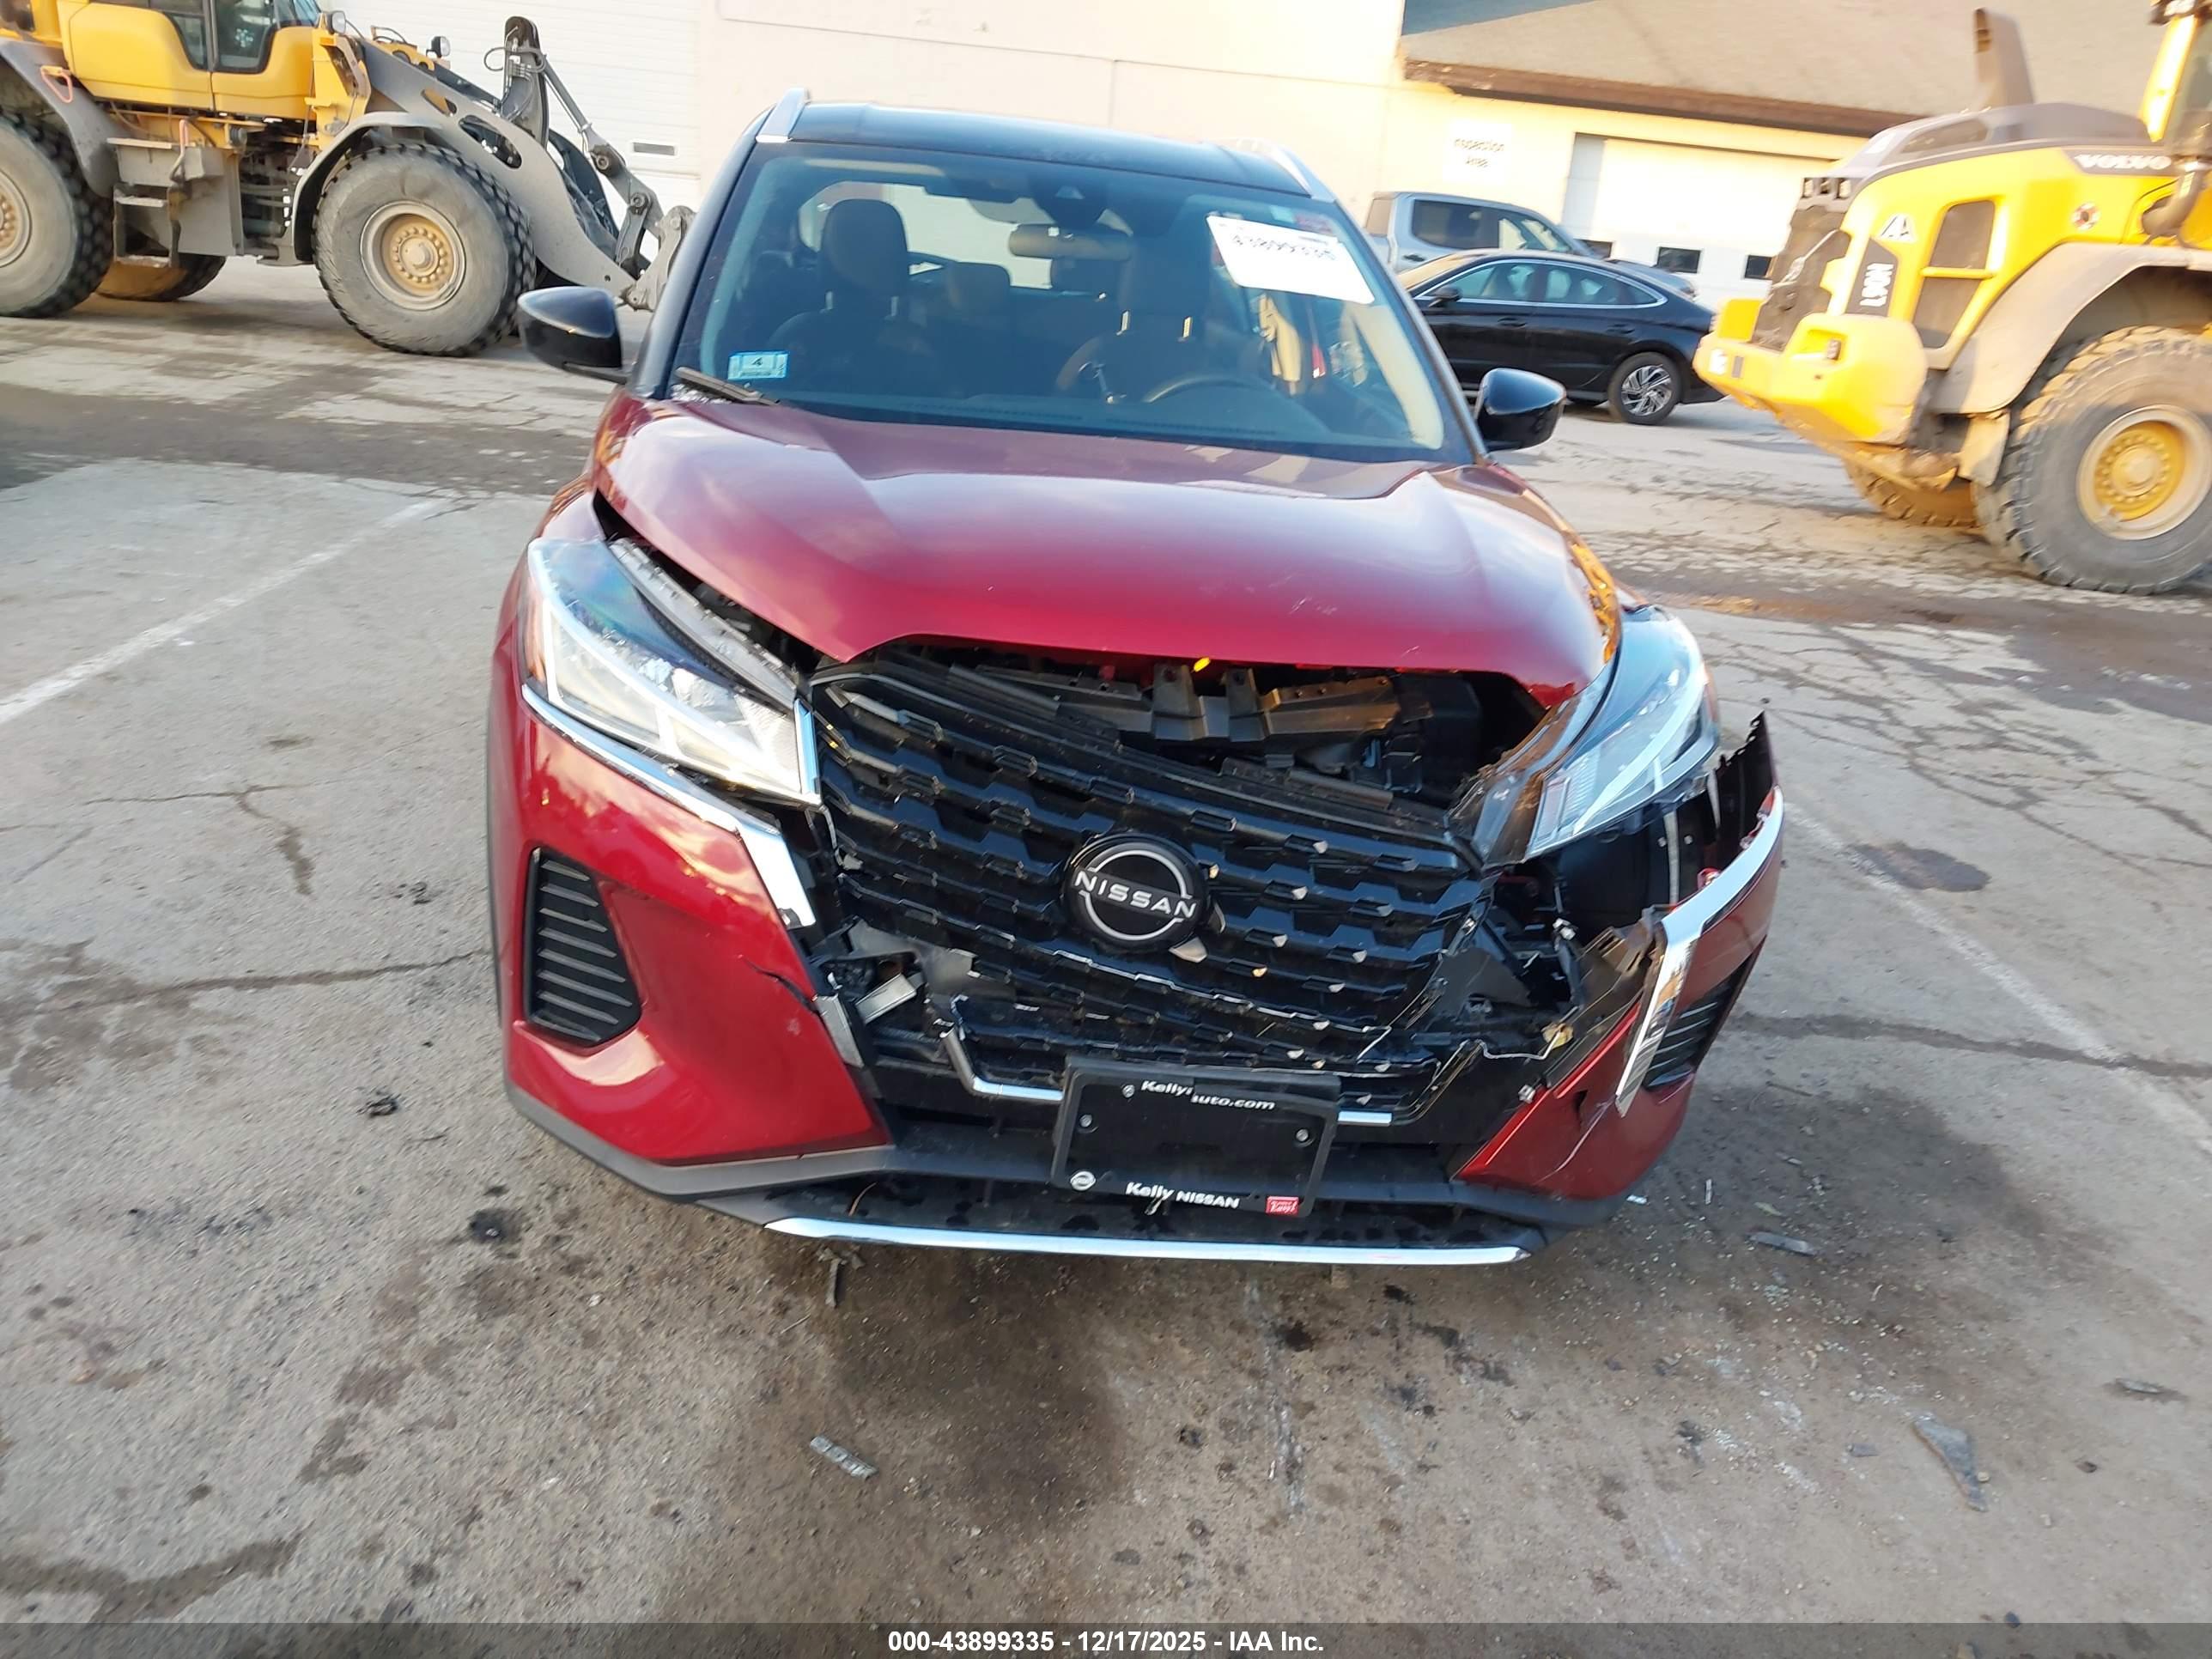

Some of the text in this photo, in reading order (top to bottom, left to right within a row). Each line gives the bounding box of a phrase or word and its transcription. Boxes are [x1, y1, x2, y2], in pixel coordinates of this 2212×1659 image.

[2074, 154, 2172, 171] VOLVO
[1074, 870, 1197, 919] NISSAN
[1126, 1182, 1241, 1209] Kelly NISSAN
